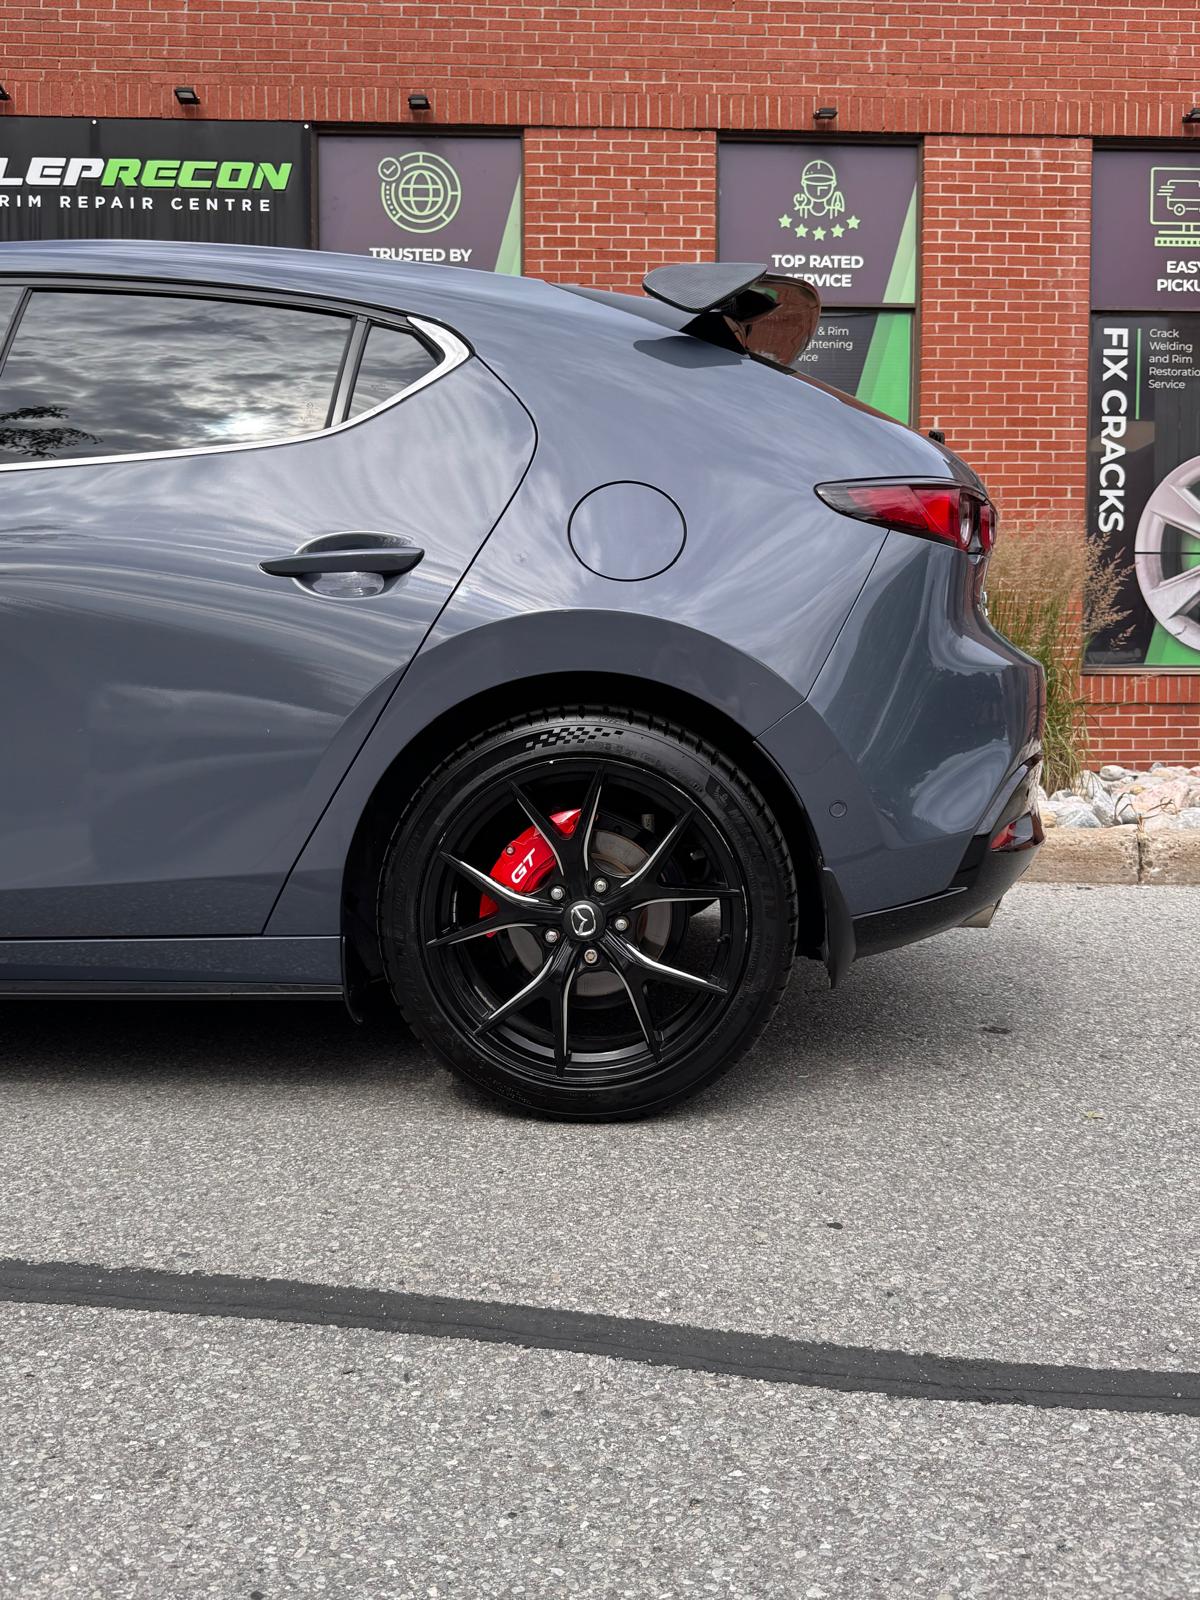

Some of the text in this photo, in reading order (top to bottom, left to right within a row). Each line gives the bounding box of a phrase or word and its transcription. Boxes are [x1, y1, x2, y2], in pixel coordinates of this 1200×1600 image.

[0, 195, 270, 212] RIM REPAIR CENTRE
[369, 247, 473, 262] TRUSTED BY
[771, 254, 864, 269] TOP RATED
[817, 326, 849, 336] & Rim
[1149, 328, 1180, 338] Crack
[1149, 341, 1193, 353] Welding
[1148, 354, 1193, 364] and Rim
[1147, 379, 1186, 389] Service
[1098, 327, 1129, 533] FIX CRACKS
[511, 847, 536, 884] GT
